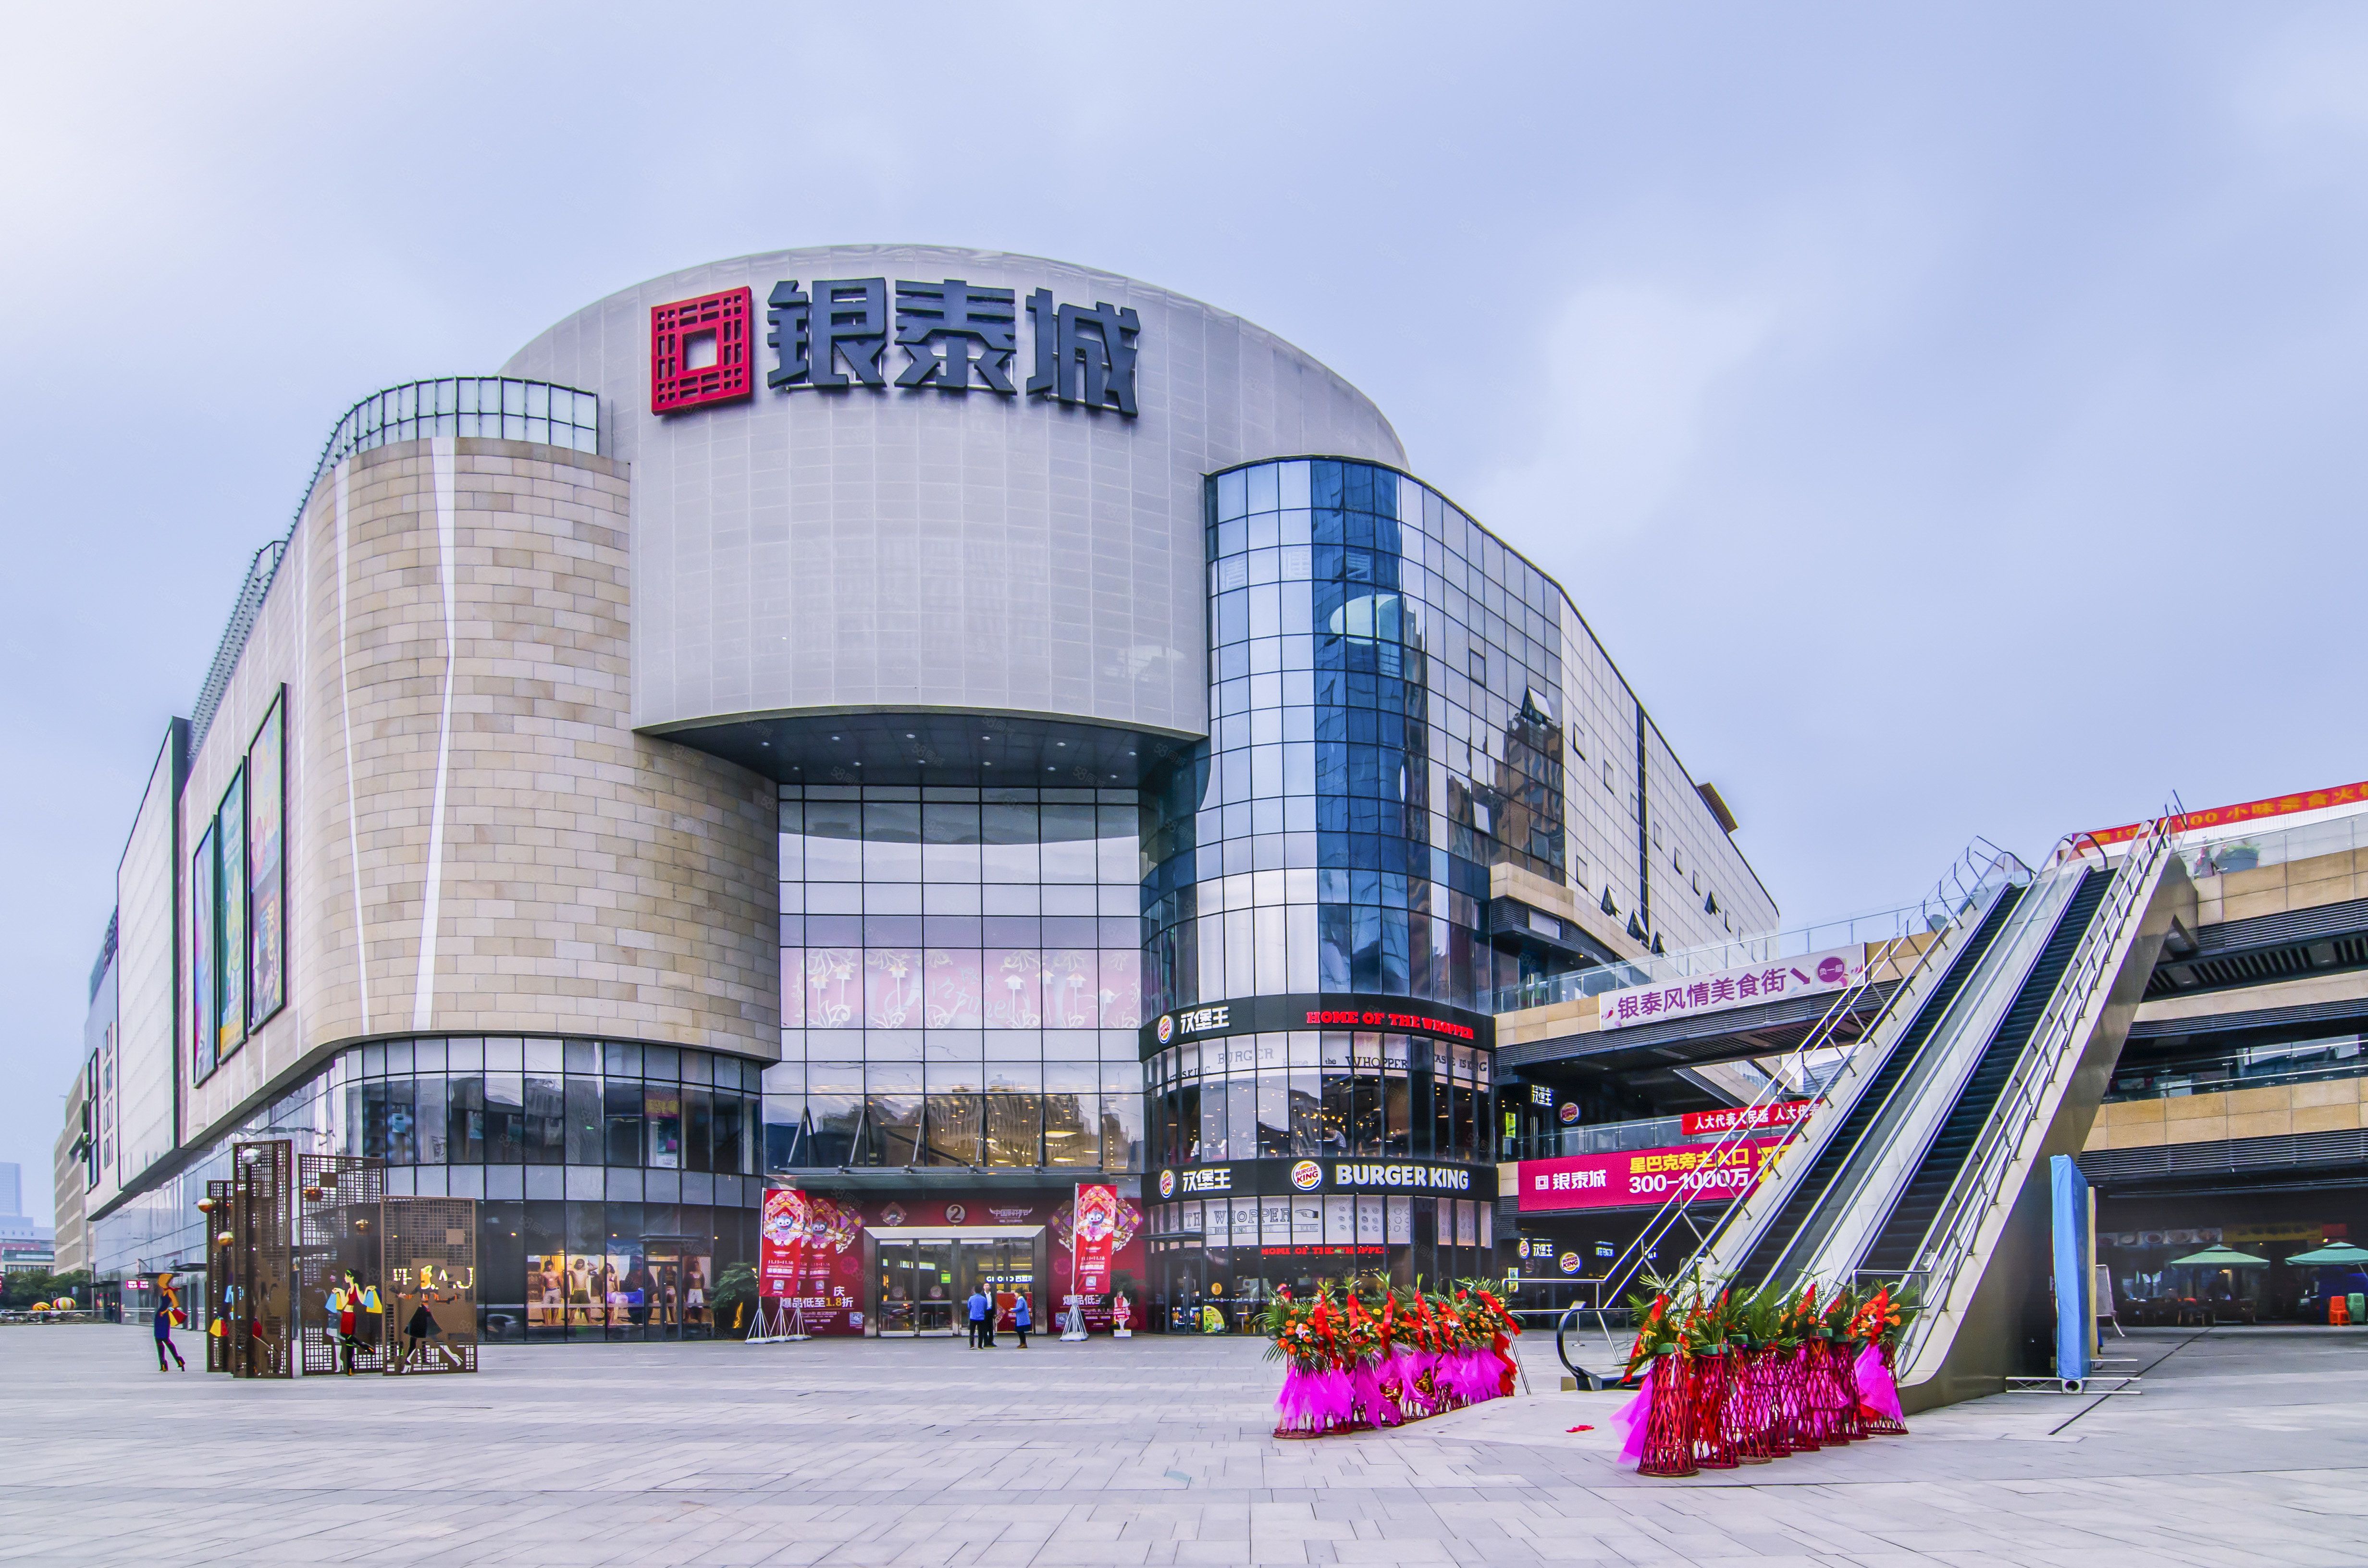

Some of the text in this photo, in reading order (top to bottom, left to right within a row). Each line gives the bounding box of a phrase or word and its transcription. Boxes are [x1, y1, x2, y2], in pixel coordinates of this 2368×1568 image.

[767, 277, 1141, 417] 银泰城
[1617, 967, 1787, 1019] 银泰风情美食街
[1180, 1006, 1230, 1034] 汉堡王
[1307, 1011, 1474, 1040] HOME OF THE WHOPPER
[1295, 1165, 1318, 1177] BURGER
[1629, 1148, 1749, 1174] 星巴克旁主入口
[1162, 1181, 1172, 1192] KING
[1182, 1168, 1232, 1192] 汉堡王
[1296, 1170, 1319, 1183] KING
[1336, 1164, 1470, 1190] BURGER KING
[1553, 1169, 1606, 1190] 银泰城
[951, 1205, 961, 1221] 2
[1533, 1244, 1553, 1257] 汉堡王
[1563, 1260, 1579, 1268] KING
[833, 1286, 845, 1297] 庆
